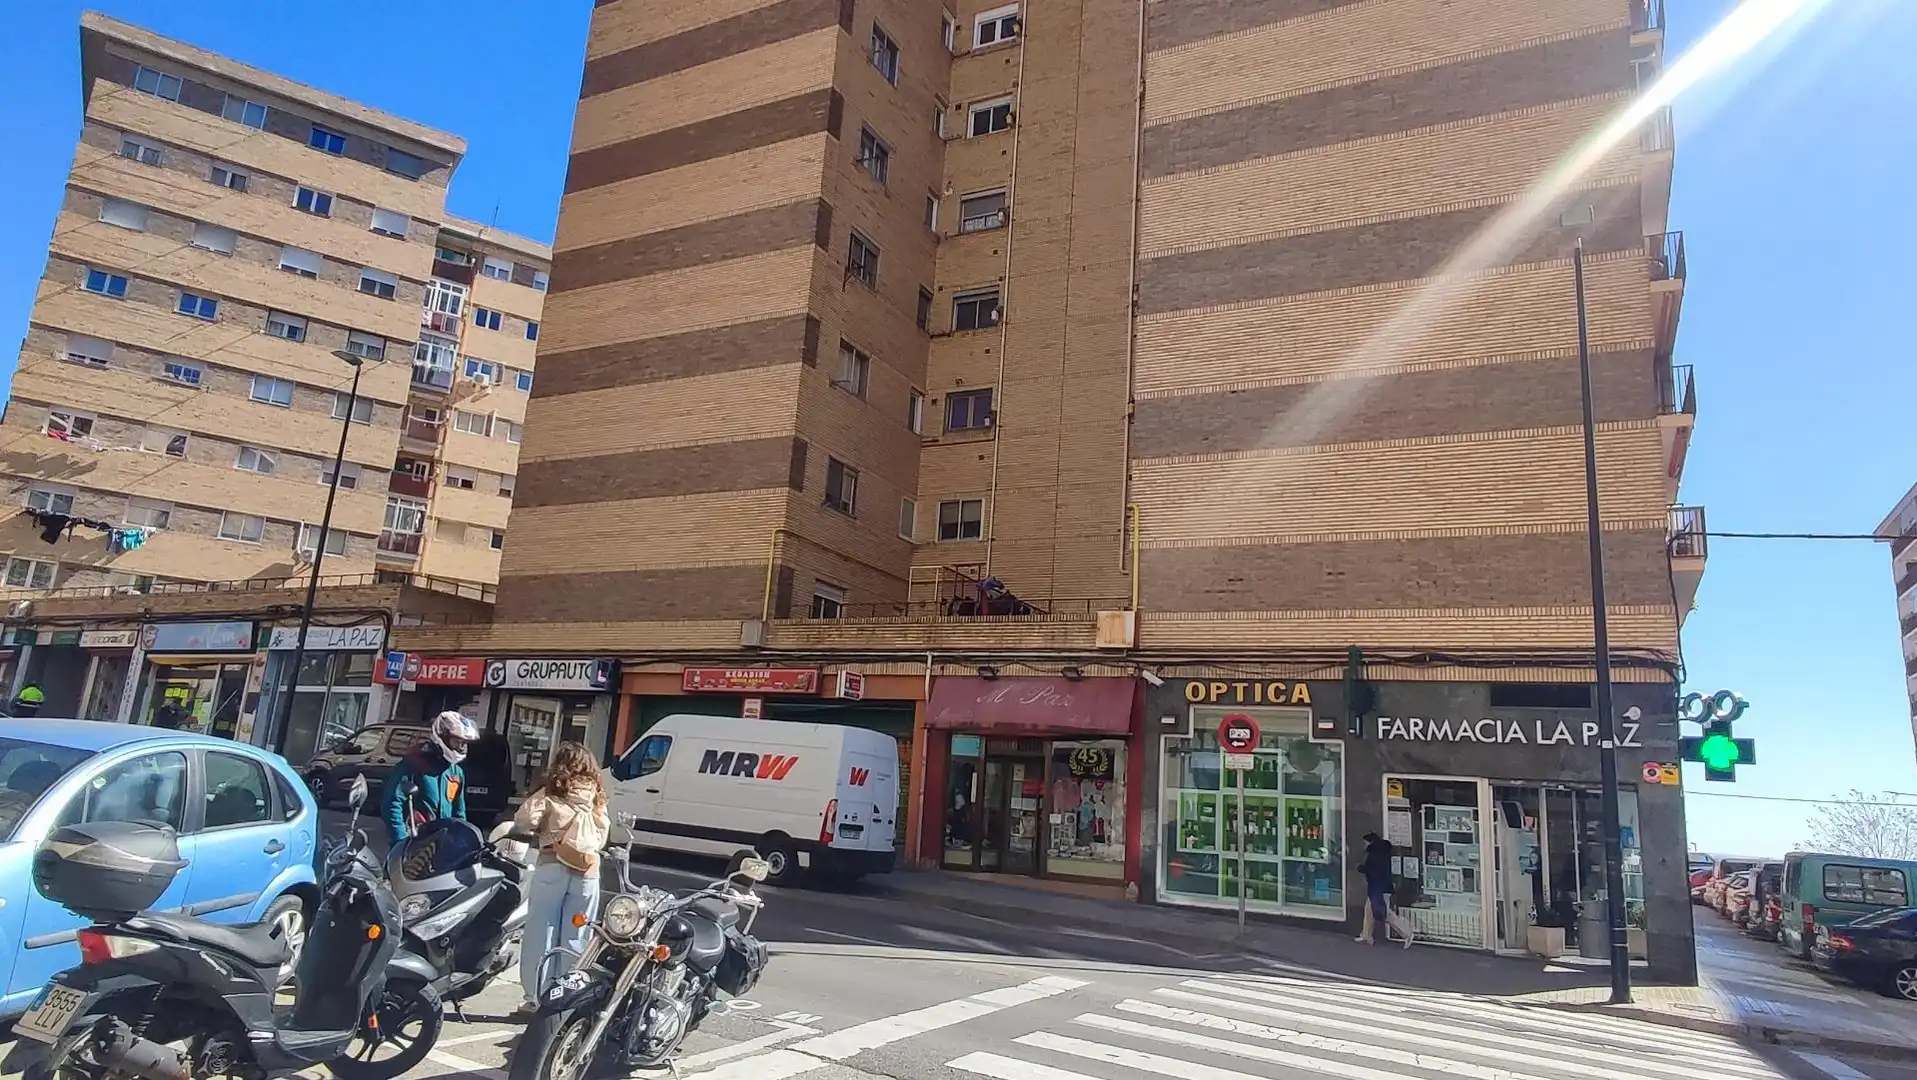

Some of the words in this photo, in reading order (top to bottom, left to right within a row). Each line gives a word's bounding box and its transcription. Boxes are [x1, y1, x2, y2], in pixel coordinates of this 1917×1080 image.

[328, 628, 346, 647] LA
[349, 627, 382, 647] PAZ
[415, 664, 468, 680] APFRE
[1185, 681, 1312, 704] OPTICA
[1377, 717, 1528, 744] FARMACIA
[1535, 720, 1575, 746] LA
[698, 749, 799, 781] MRW
[1077, 748, 1098, 763] 45
[849, 766, 870, 787] W
[45, 989, 81, 1012] 3555
[34, 1007, 65, 1030] LLV
